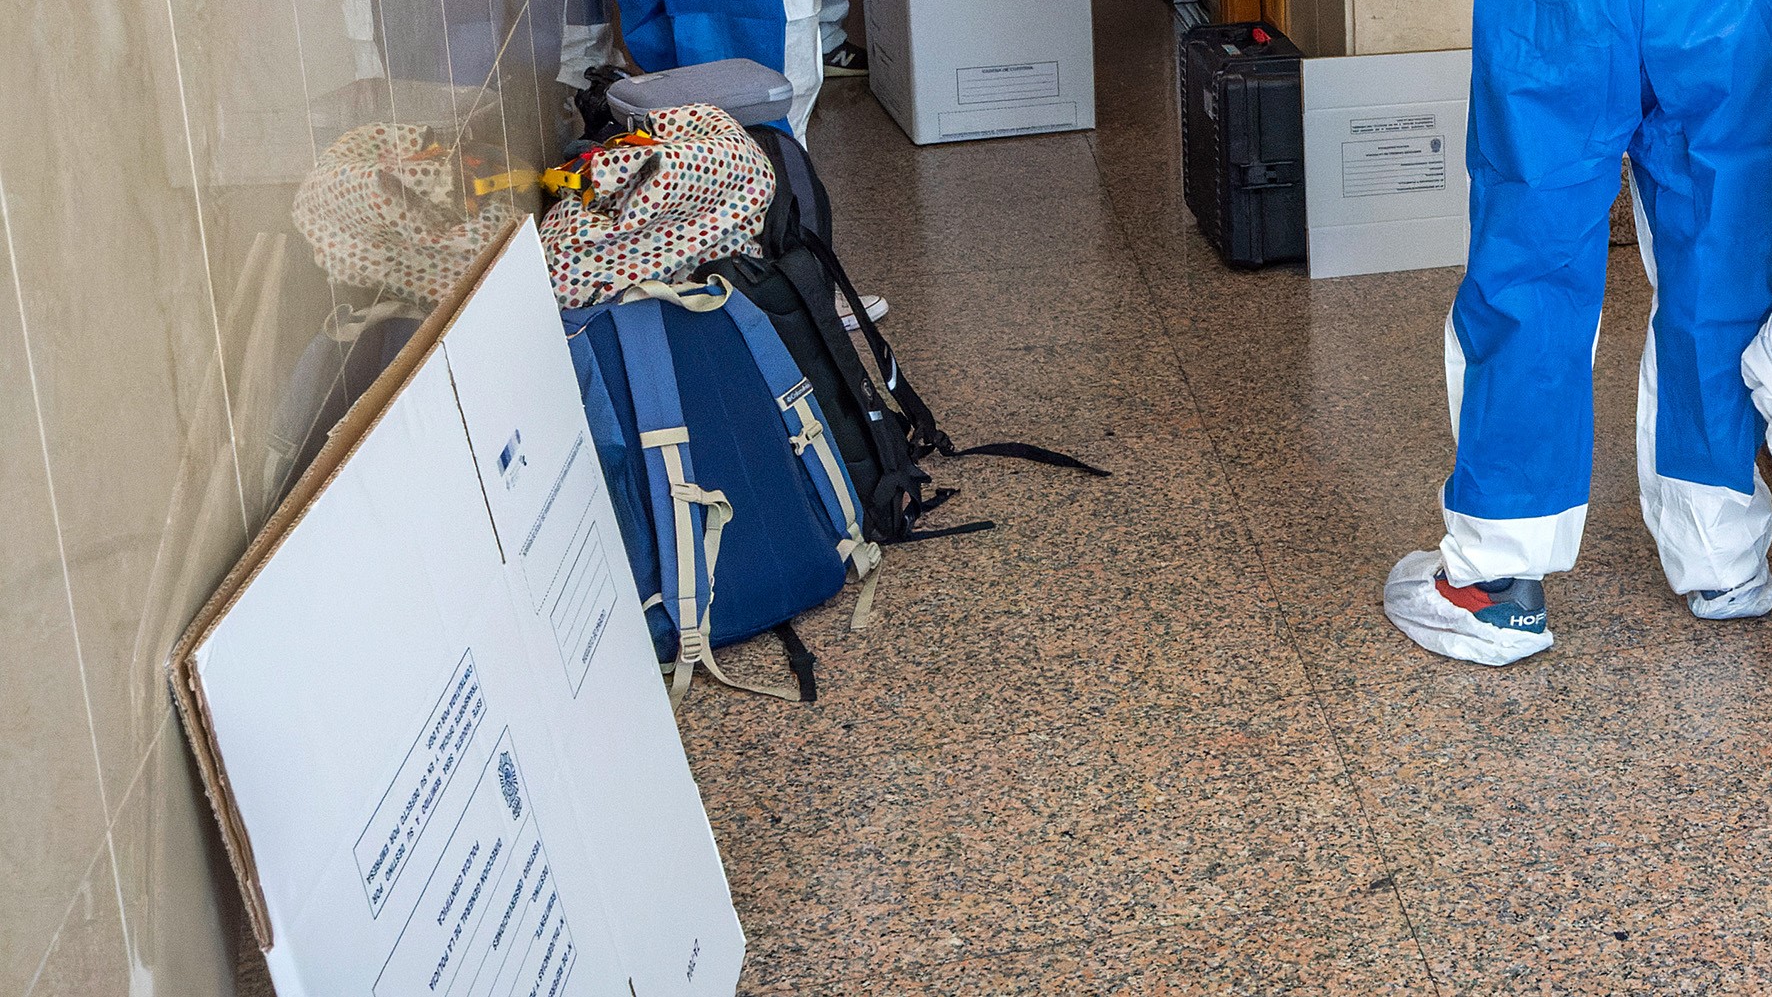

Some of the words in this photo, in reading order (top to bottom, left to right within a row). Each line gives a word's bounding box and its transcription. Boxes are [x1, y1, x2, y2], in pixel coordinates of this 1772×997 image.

[831, 50, 856, 67] N
[400, 788, 420, 825] DEFECTO
[366, 844, 389, 885] EMPRESA
[385, 843, 405, 881] DESTINO
[460, 883, 481, 924] GENERAL
